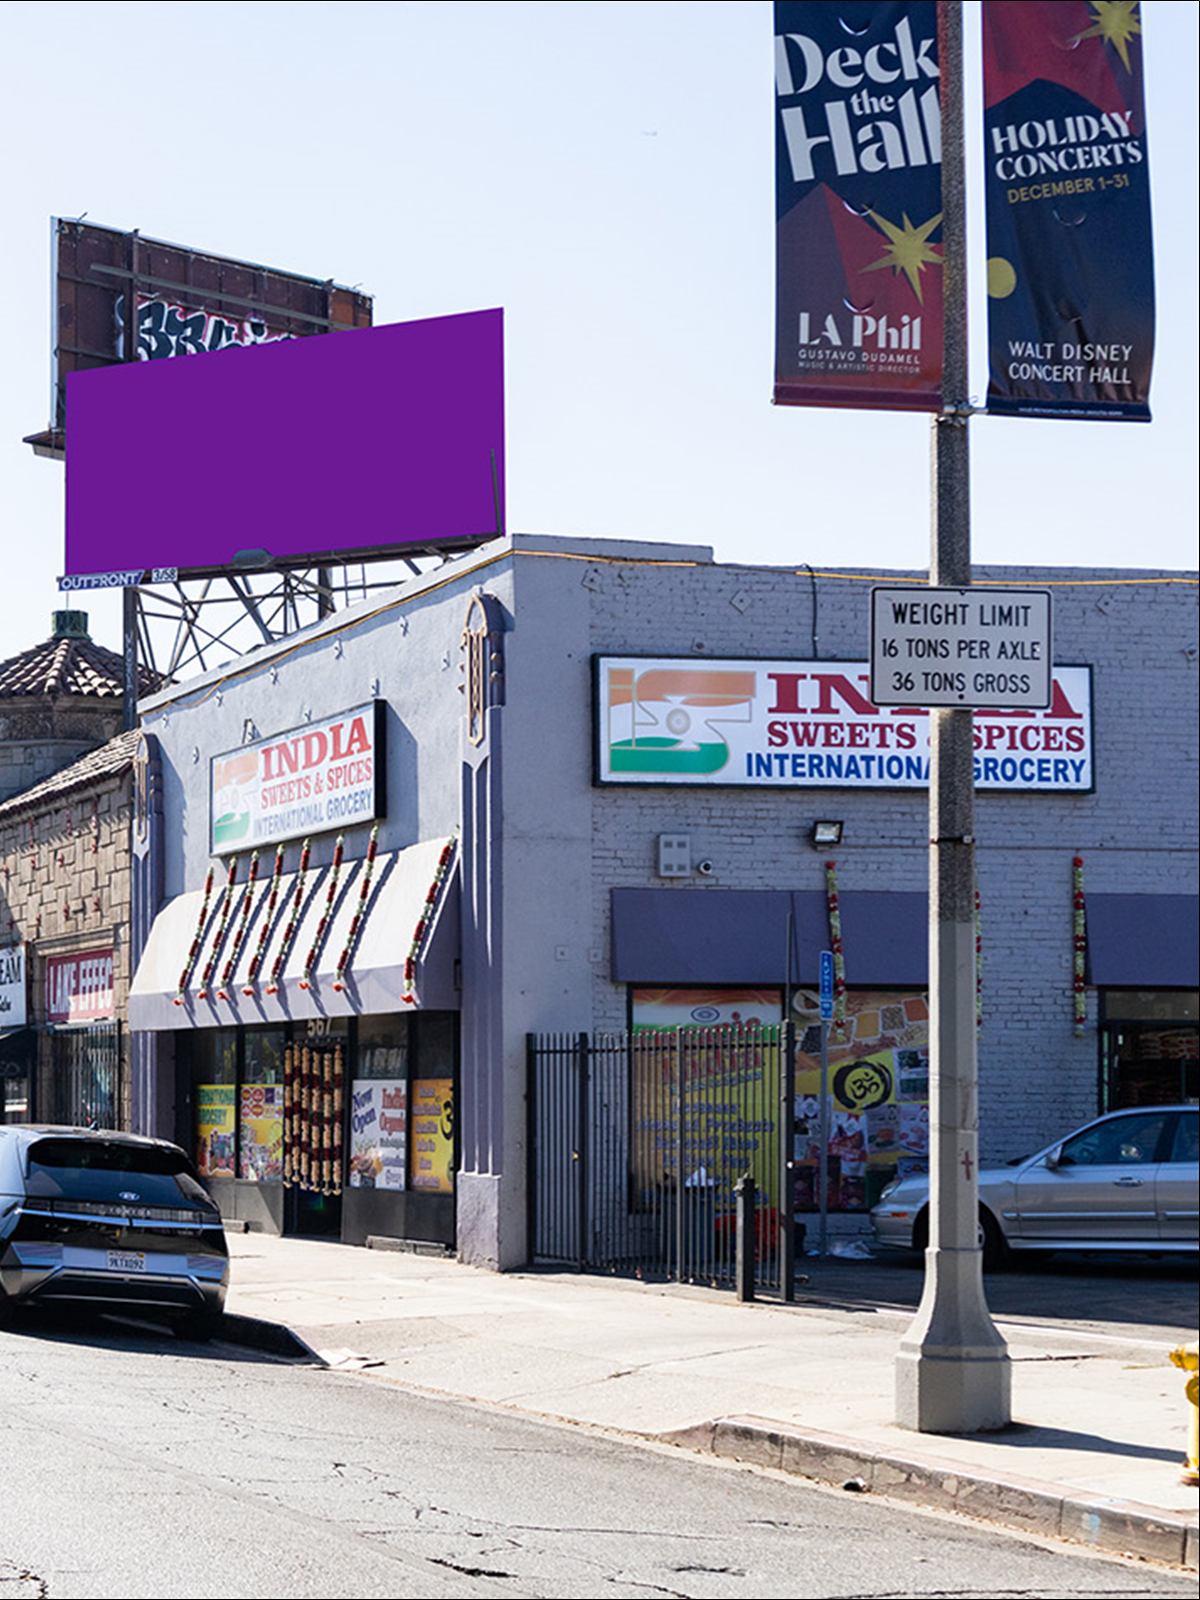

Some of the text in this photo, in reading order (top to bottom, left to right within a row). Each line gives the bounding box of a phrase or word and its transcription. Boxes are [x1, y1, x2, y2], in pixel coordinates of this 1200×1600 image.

[775, 16, 940, 95] Deck
[850, 88, 895, 116] the
[781, 86, 942, 182] Hall
[991, 110, 1134, 154] HOLIDAY
[995, 140, 1143, 181] CONCERTS
[1007, 179, 1095, 204] DECEMBER
[799, 312, 921, 350] LA Phil
[798, 349, 920, 364] GUSTAVO DUDAMEL
[1009, 341, 1133, 362] WALT DISNEY
[1009, 362, 1132, 384] CONCERT HALL
[61, 572, 139, 589] OUTFRONT
[892, 603, 1031, 627] WEIGHT LIMIT
[881, 638, 1041, 660] 16 TONS PER AXLE
[767, 673, 1084, 719] INA
[892, 671, 1030, 693] 36 TONS GROSS
[767, 721, 916, 749] SWEETS
[261, 717, 372, 782] INDIA
[746, 753, 930, 780] INTERNATION
[261, 757, 372, 809] SWEETS & SPICES
[253, 788, 372, 839] INTERNATIONAL GROCERY
[353, 1087, 373, 1113] Now
[352, 1107, 377, 1135] Open
